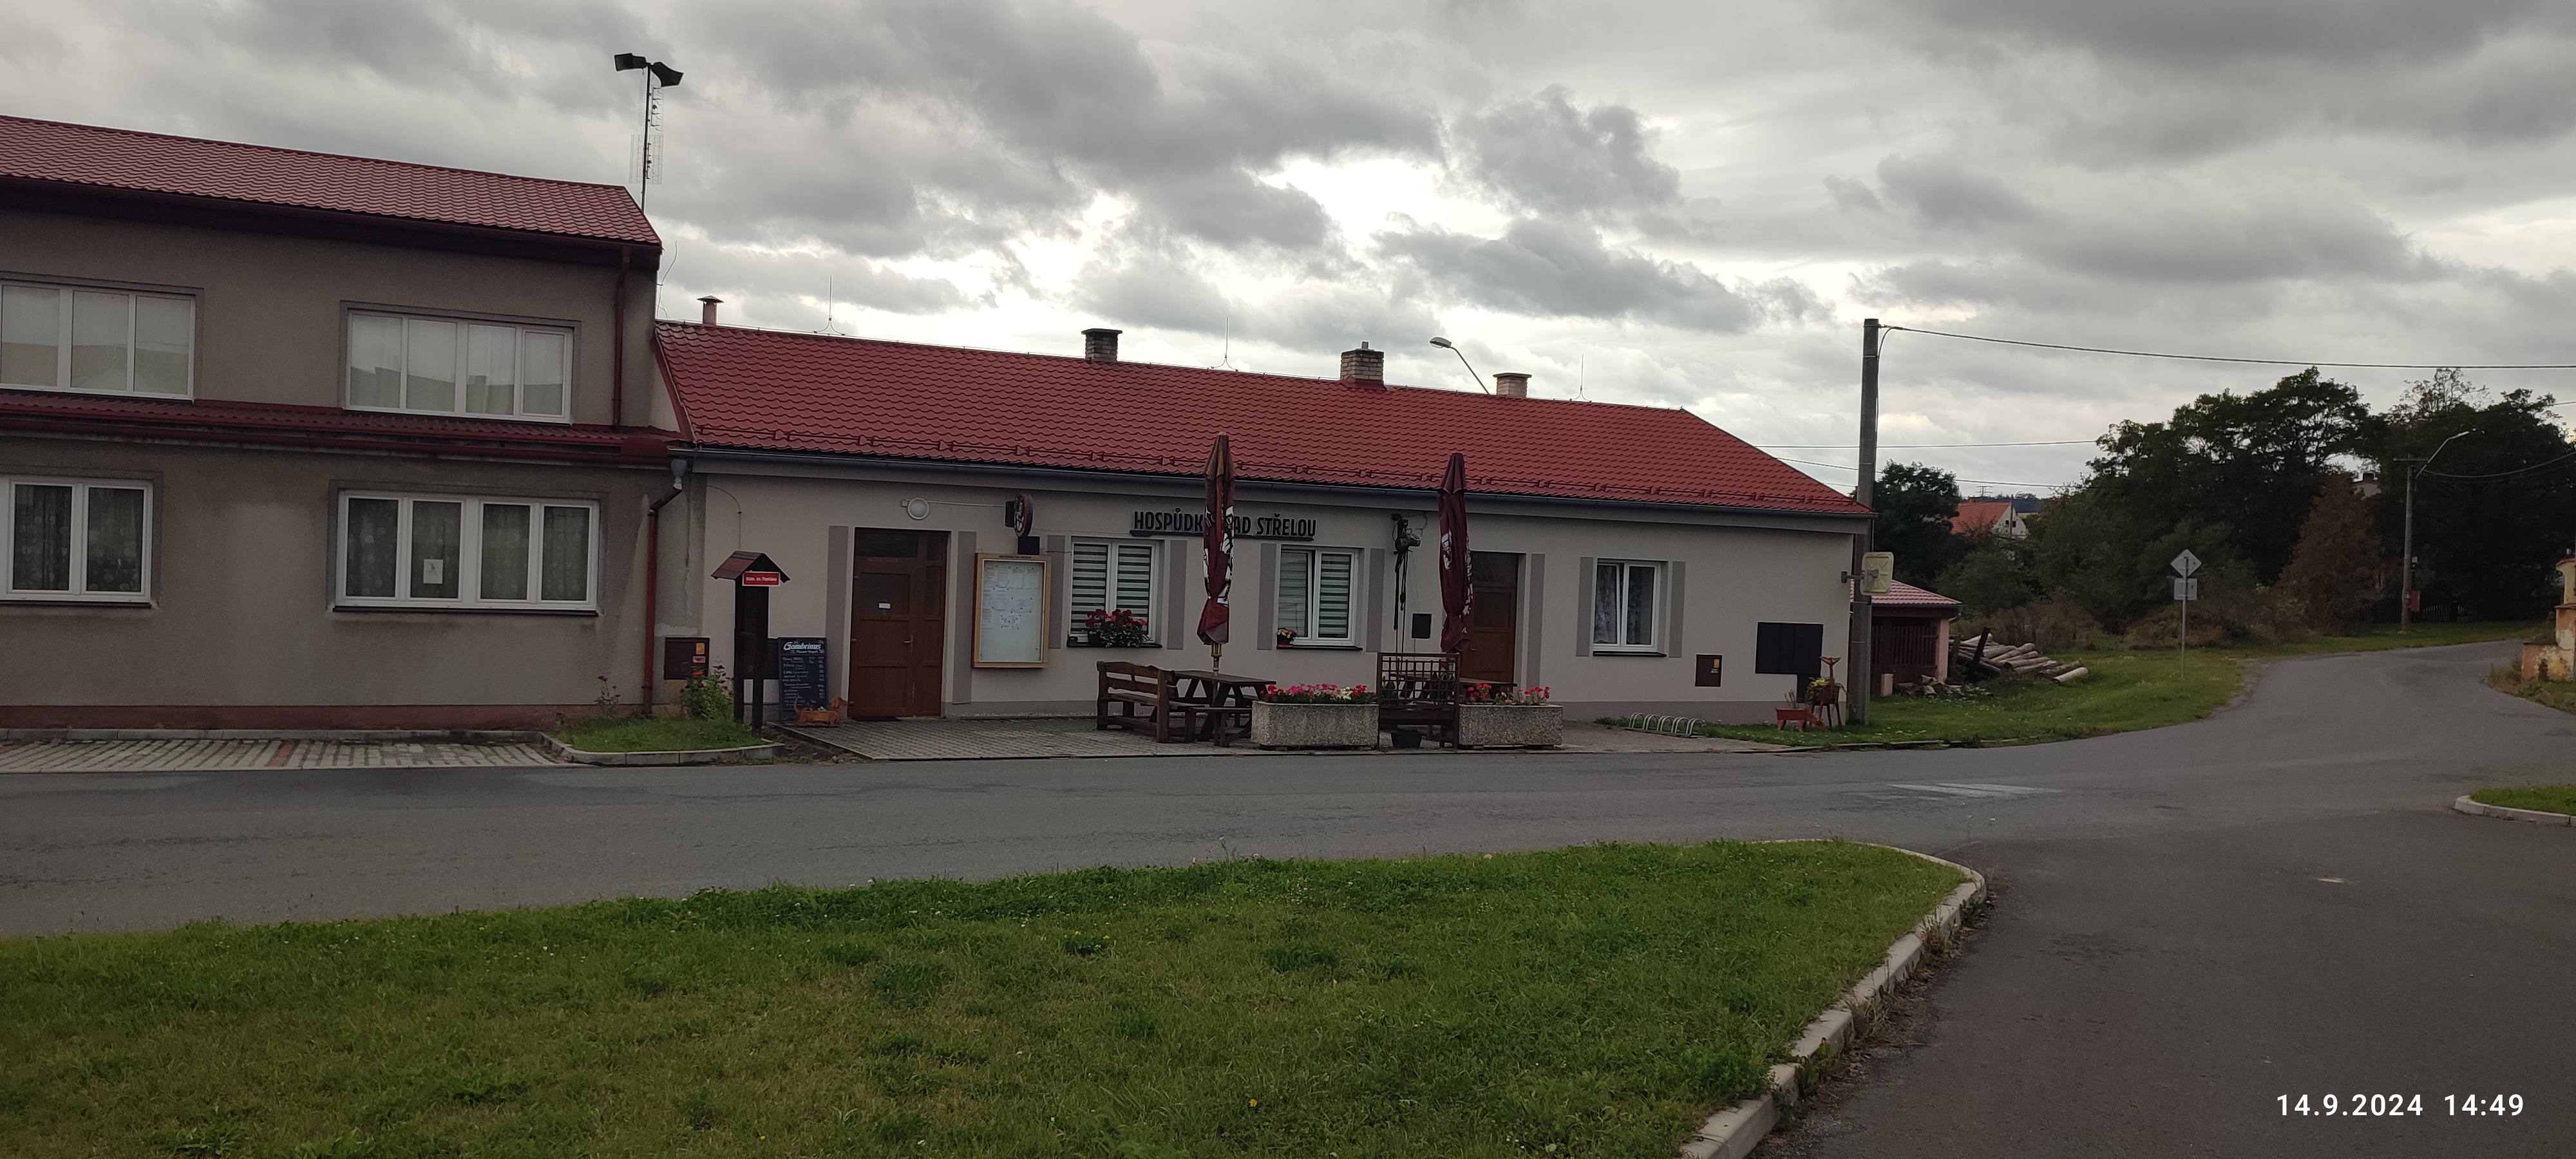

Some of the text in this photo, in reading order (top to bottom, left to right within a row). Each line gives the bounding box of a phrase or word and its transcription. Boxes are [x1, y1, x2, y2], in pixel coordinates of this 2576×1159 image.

[1134, 508, 1316, 537] HOSPŮDK AD STŘELOU
[783, 641, 822, 651] Gambrinus
